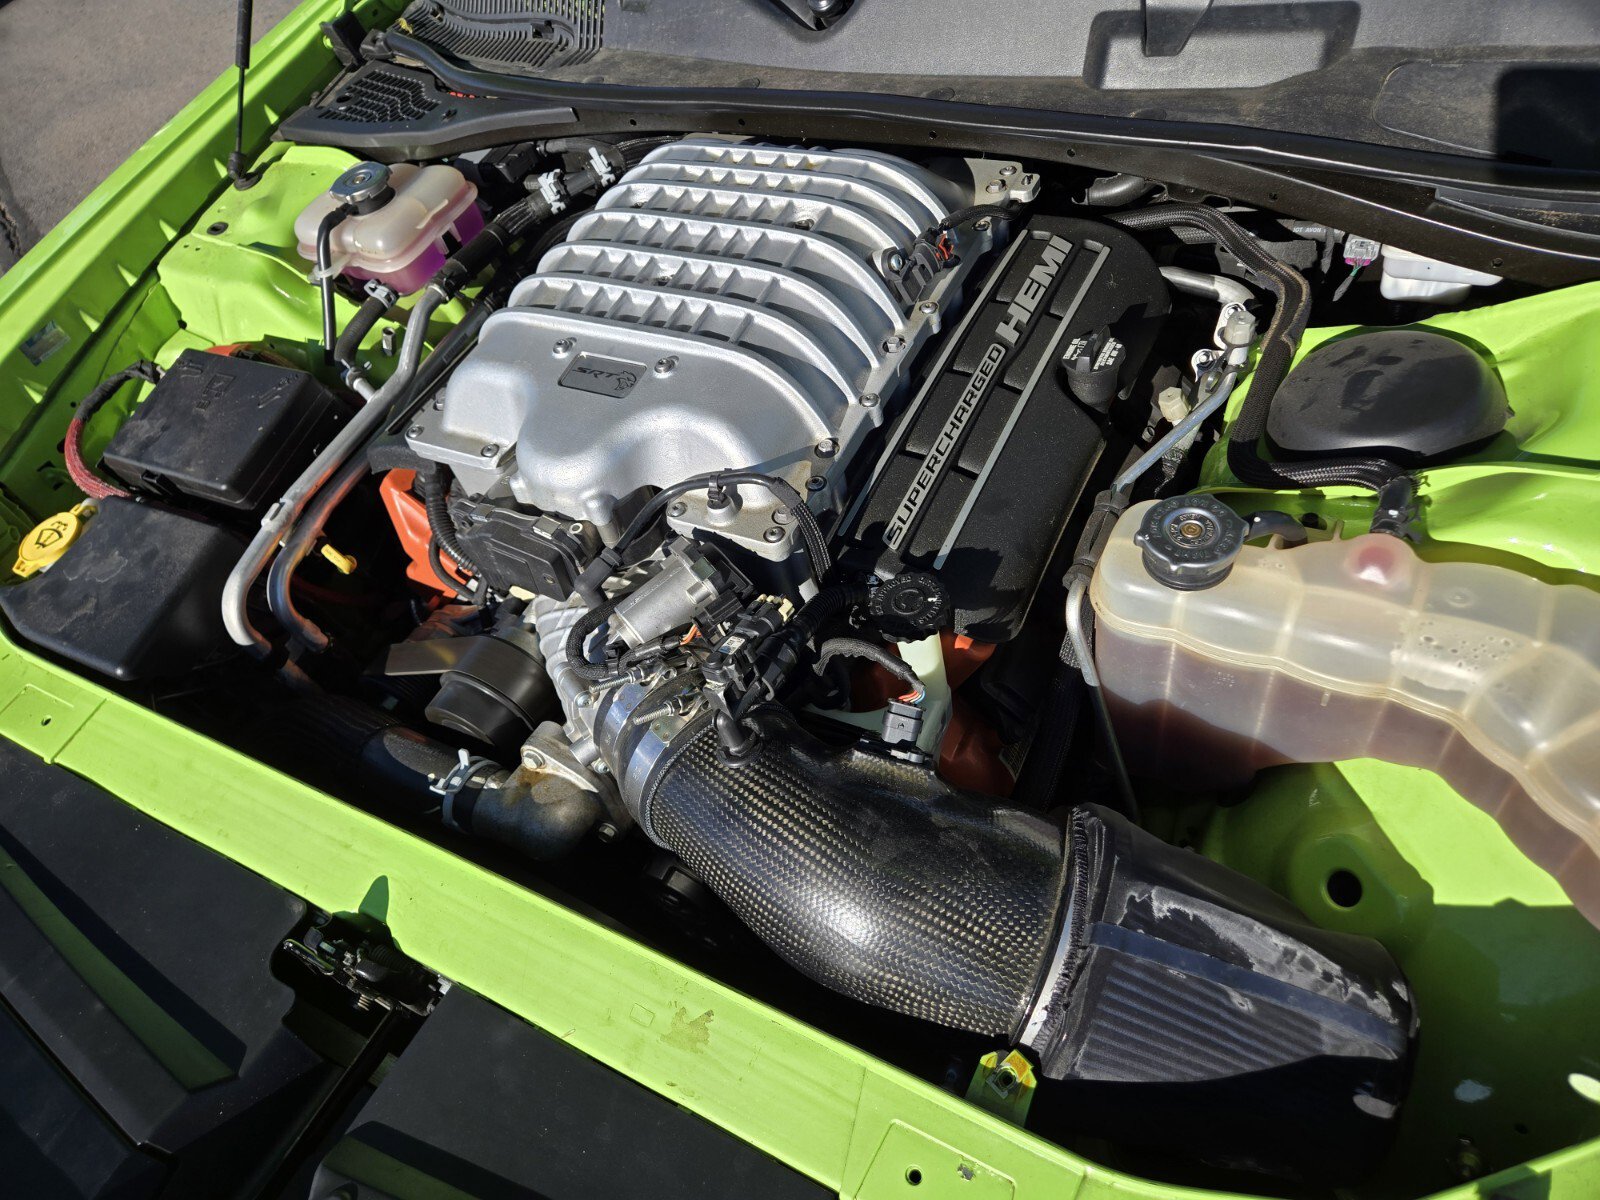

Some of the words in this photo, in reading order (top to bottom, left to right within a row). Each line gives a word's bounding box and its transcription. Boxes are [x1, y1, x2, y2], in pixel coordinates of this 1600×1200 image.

[572, 367, 620, 379] SRT
[885, 345, 1004, 548] SUPERCHARGED
[995, 235, 1074, 346] HEMI
